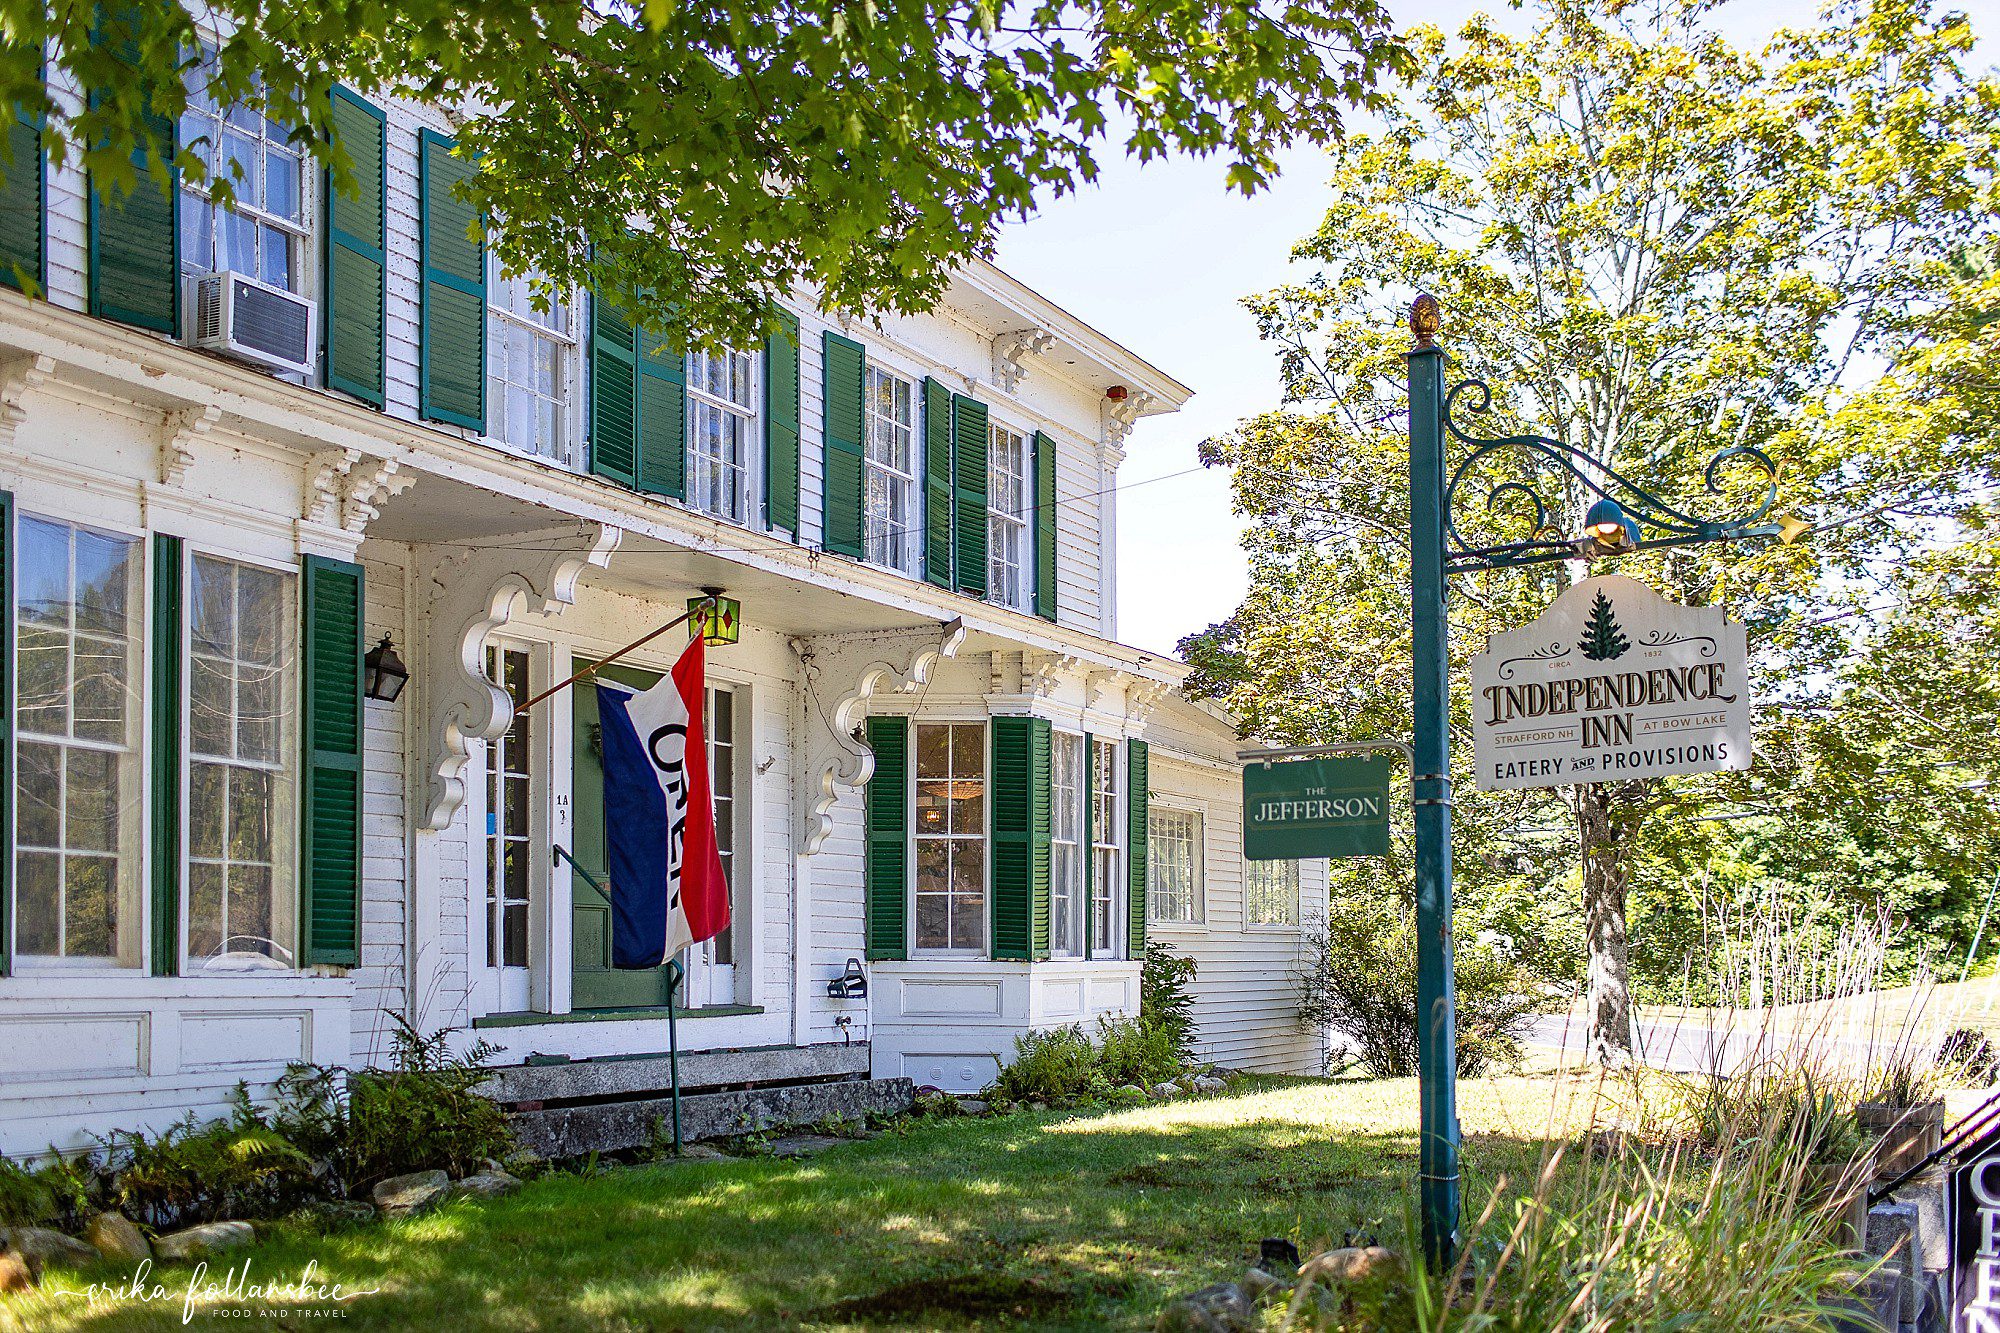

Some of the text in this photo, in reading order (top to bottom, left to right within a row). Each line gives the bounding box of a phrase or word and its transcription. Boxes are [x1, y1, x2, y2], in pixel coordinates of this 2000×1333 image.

[1643, 650, 1662, 658] 1832
[1548, 661, 1571, 669] CIRCA
[1482, 662, 1737, 727] INDEPENDENCE
[1580, 712, 1634, 749] INN
[1643, 714, 1726, 731] AT BOW LAKE
[1494, 729, 1574, 745] STRAFFORD NH
[1495, 742, 1728, 780] EATERY AND PROVISIONS
[1306, 786, 1327, 796] THE
[1255, 797, 1379, 822] JEFFERSON
